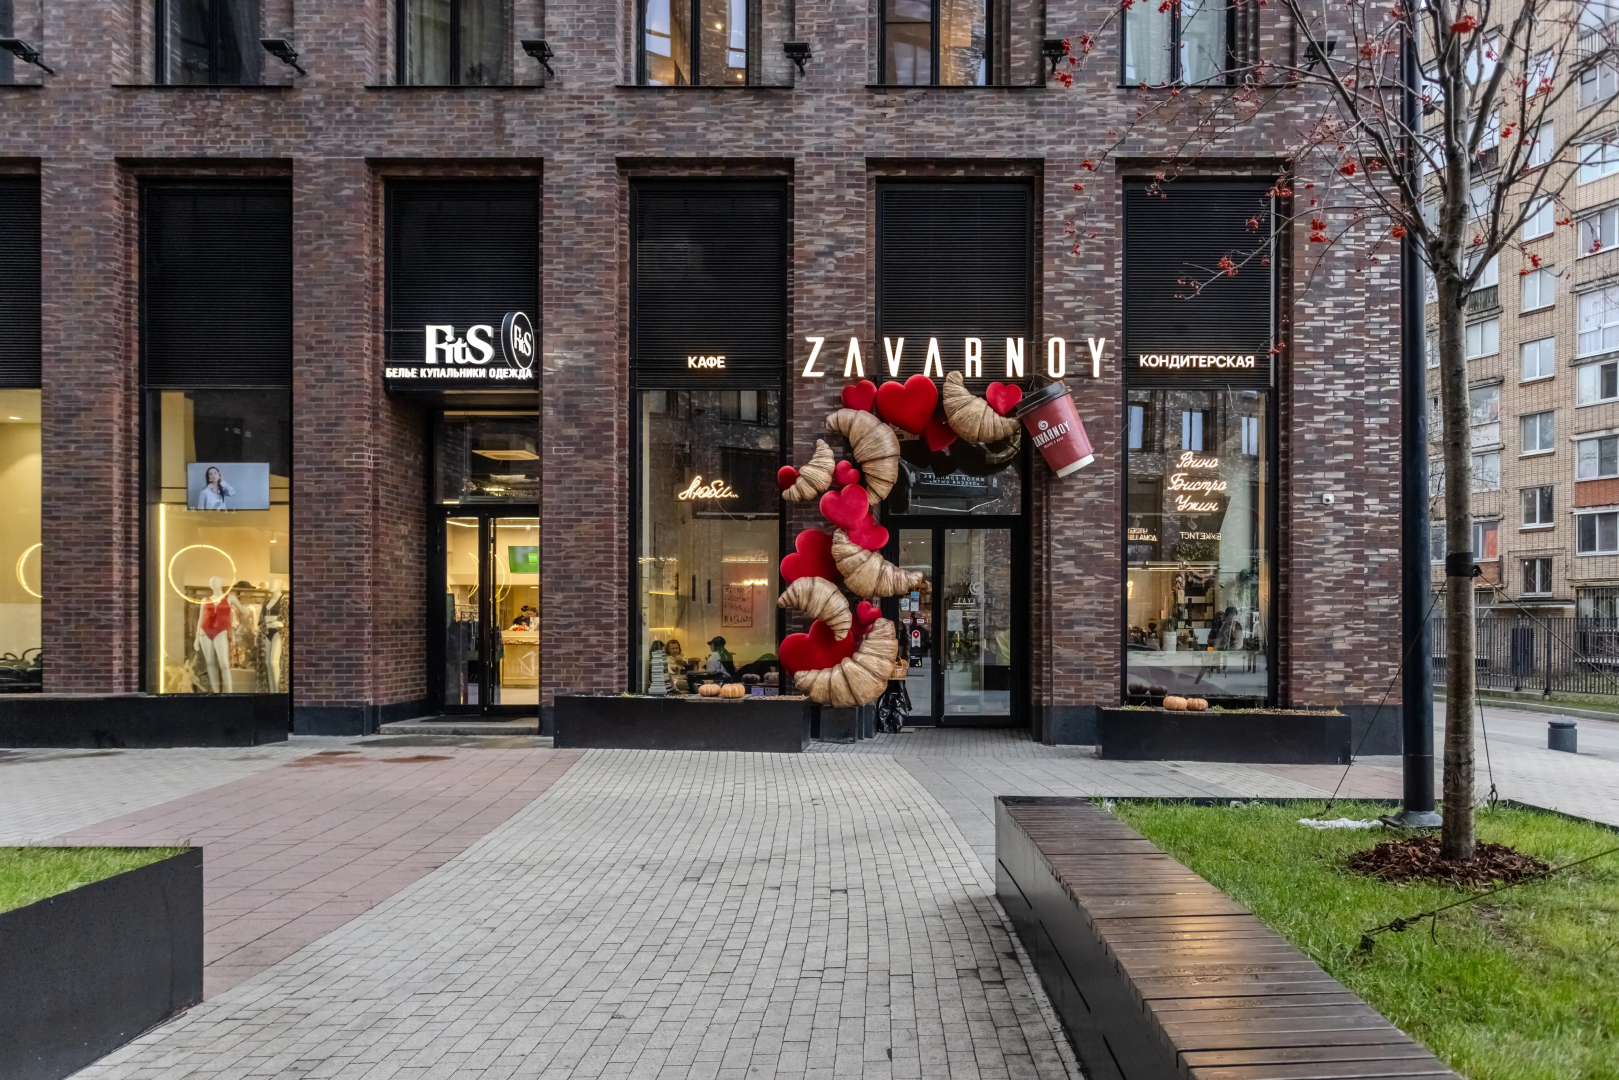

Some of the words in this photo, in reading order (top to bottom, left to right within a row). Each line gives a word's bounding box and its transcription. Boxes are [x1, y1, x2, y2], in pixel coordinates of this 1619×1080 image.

[687, 355, 726, 369] КАФЕ
[801, 337, 1106, 378] ZAVARNOY
[1139, 354, 1256, 369] КОНДИТЕРСКАЯ
[385, 367, 418, 379] БЕЛЬЕ
[420, 367, 487, 379] КУПАЛЬНИКИ
[488, 367, 533, 380] ОДЕЖДА
[1032, 420, 1071, 448] ZAVARNOY
[1176, 451, 1219, 469] Вино
[1167, 472, 1228, 497] Бистро
[1175, 494, 1219, 512] Ужин
